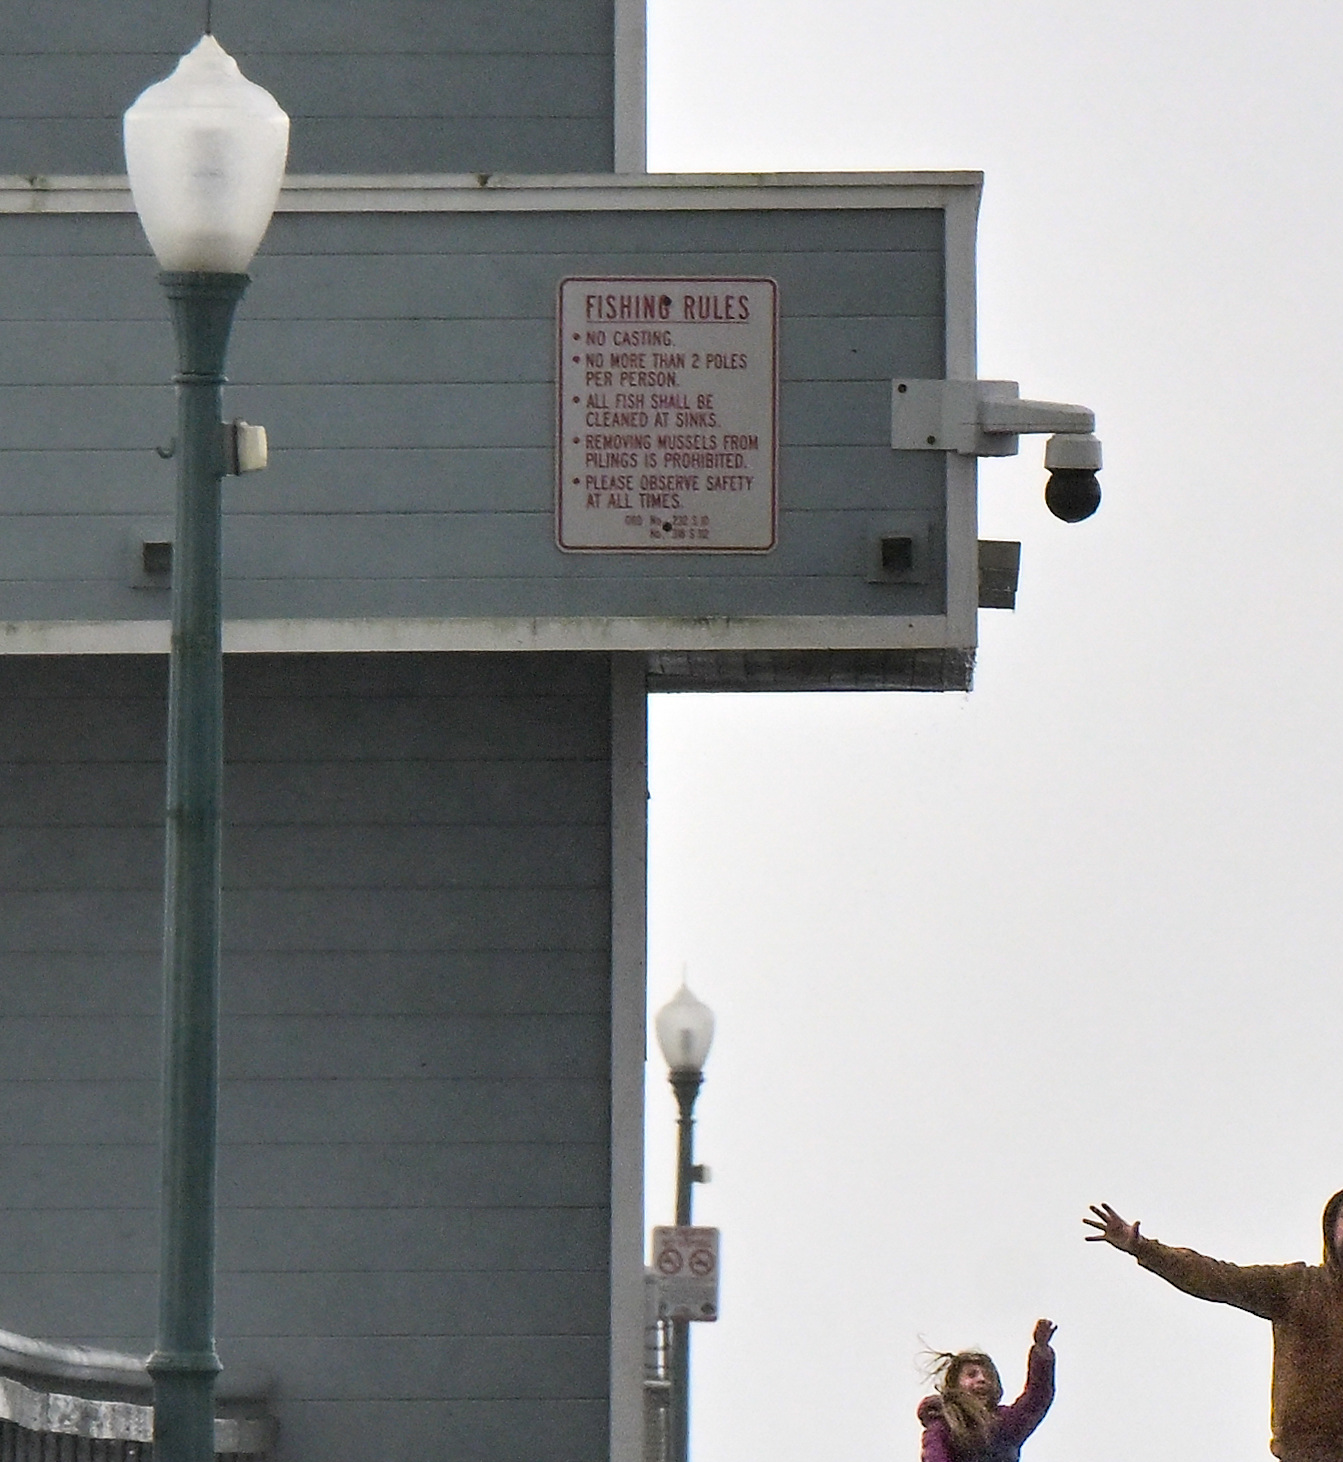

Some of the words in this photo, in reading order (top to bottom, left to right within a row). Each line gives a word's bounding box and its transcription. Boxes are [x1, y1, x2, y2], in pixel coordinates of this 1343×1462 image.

[586, 295, 671, 321] FISHING
[685, 295, 750, 320] RULES
[586, 331, 606, 346] NO
[614, 331, 676, 347] CASTING.
[586, 354, 604, 369] NO
[610, 353, 646, 369] MORE
[653, 353, 685, 369] THAN
[692, 353, 700, 369] 2
[706, 353, 748, 369] POLES
[586, 371, 613, 387] PER
[620, 371, 680, 387] PERSON.
[586, 394, 608, 409] ALL
[616, 394, 644, 409] FISH
[651, 394, 690, 409] SHALL
[697, 394, 714, 409] BE
[586, 413, 648, 428] CLEANED
[655, 413, 670, 428] AT
[676, 413, 721, 428] SINKS.
[586, 435, 651, 450] REMOVING
[658, 435, 717, 450] MUSSELS
[723, 435, 759, 450] FROM
[586, 453, 638, 469] PILINGS
[645, 453, 657, 469] IS
[664, 453, 748, 469] PROHIBITED.
[586, 476, 633, 491] PLEASE
[640, 476, 699, 491] OBSERVE
[707, 476, 754, 491] SAFETY
[587, 493, 601, 509] AT
[608, 493, 633, 509] ALL
[639, 493, 684, 509] TIMES.
